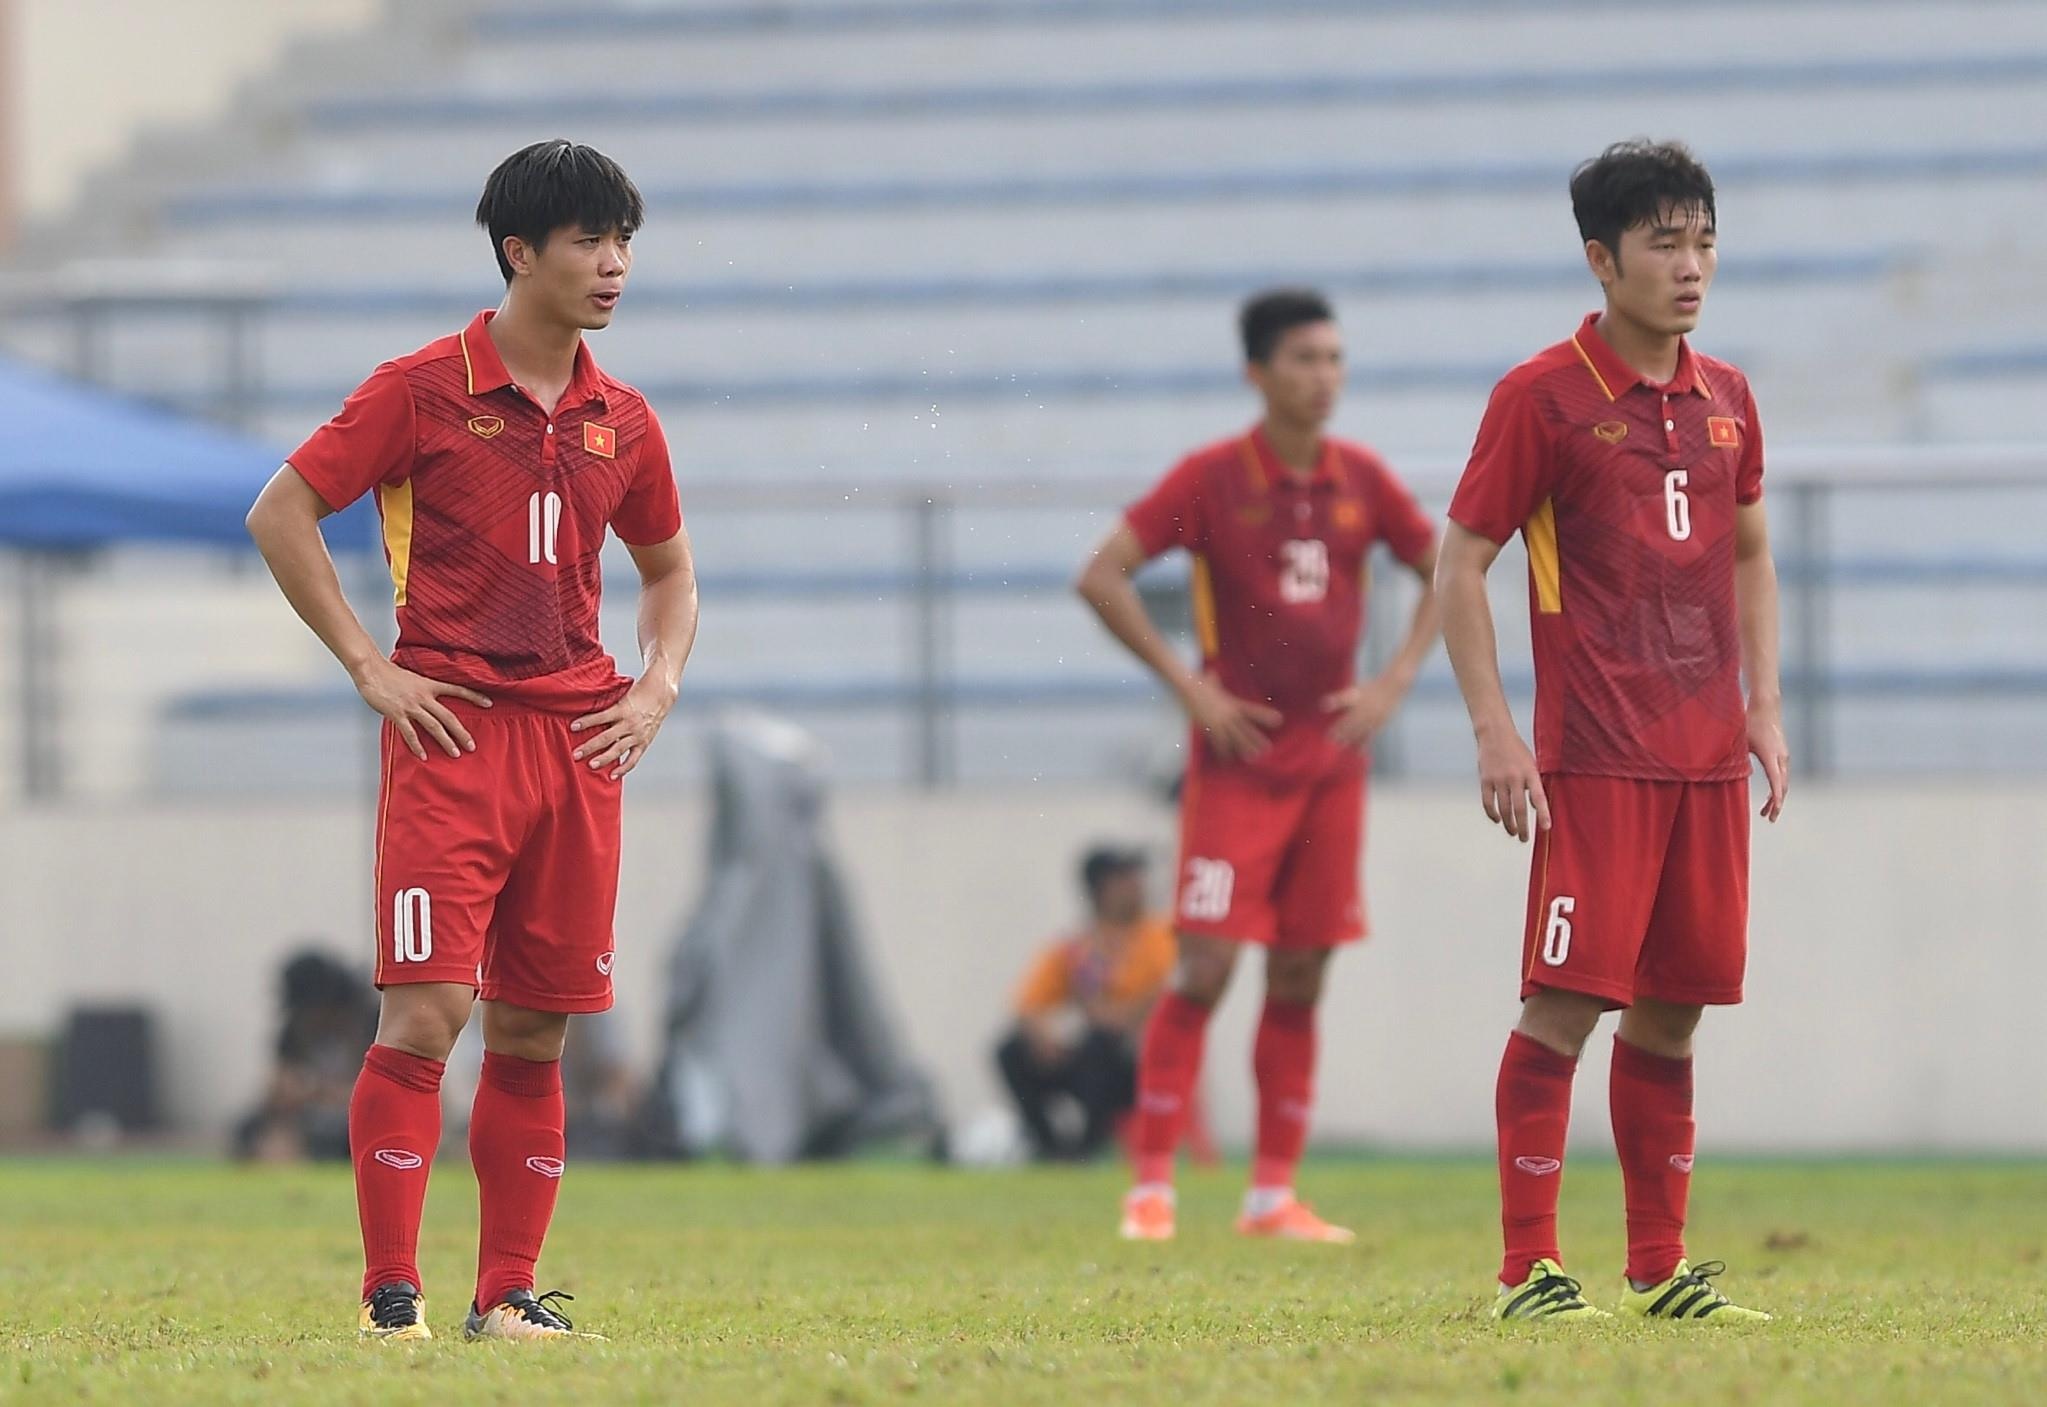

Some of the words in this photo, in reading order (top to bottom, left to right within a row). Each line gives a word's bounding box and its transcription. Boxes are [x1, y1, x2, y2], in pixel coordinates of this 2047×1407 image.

[529, 491, 562, 564] 10
[1664, 470, 1692, 540] 6
[1182, 857, 1234, 921] 20
[394, 887, 432, 963] 10
[1542, 896, 1575, 967] 6
